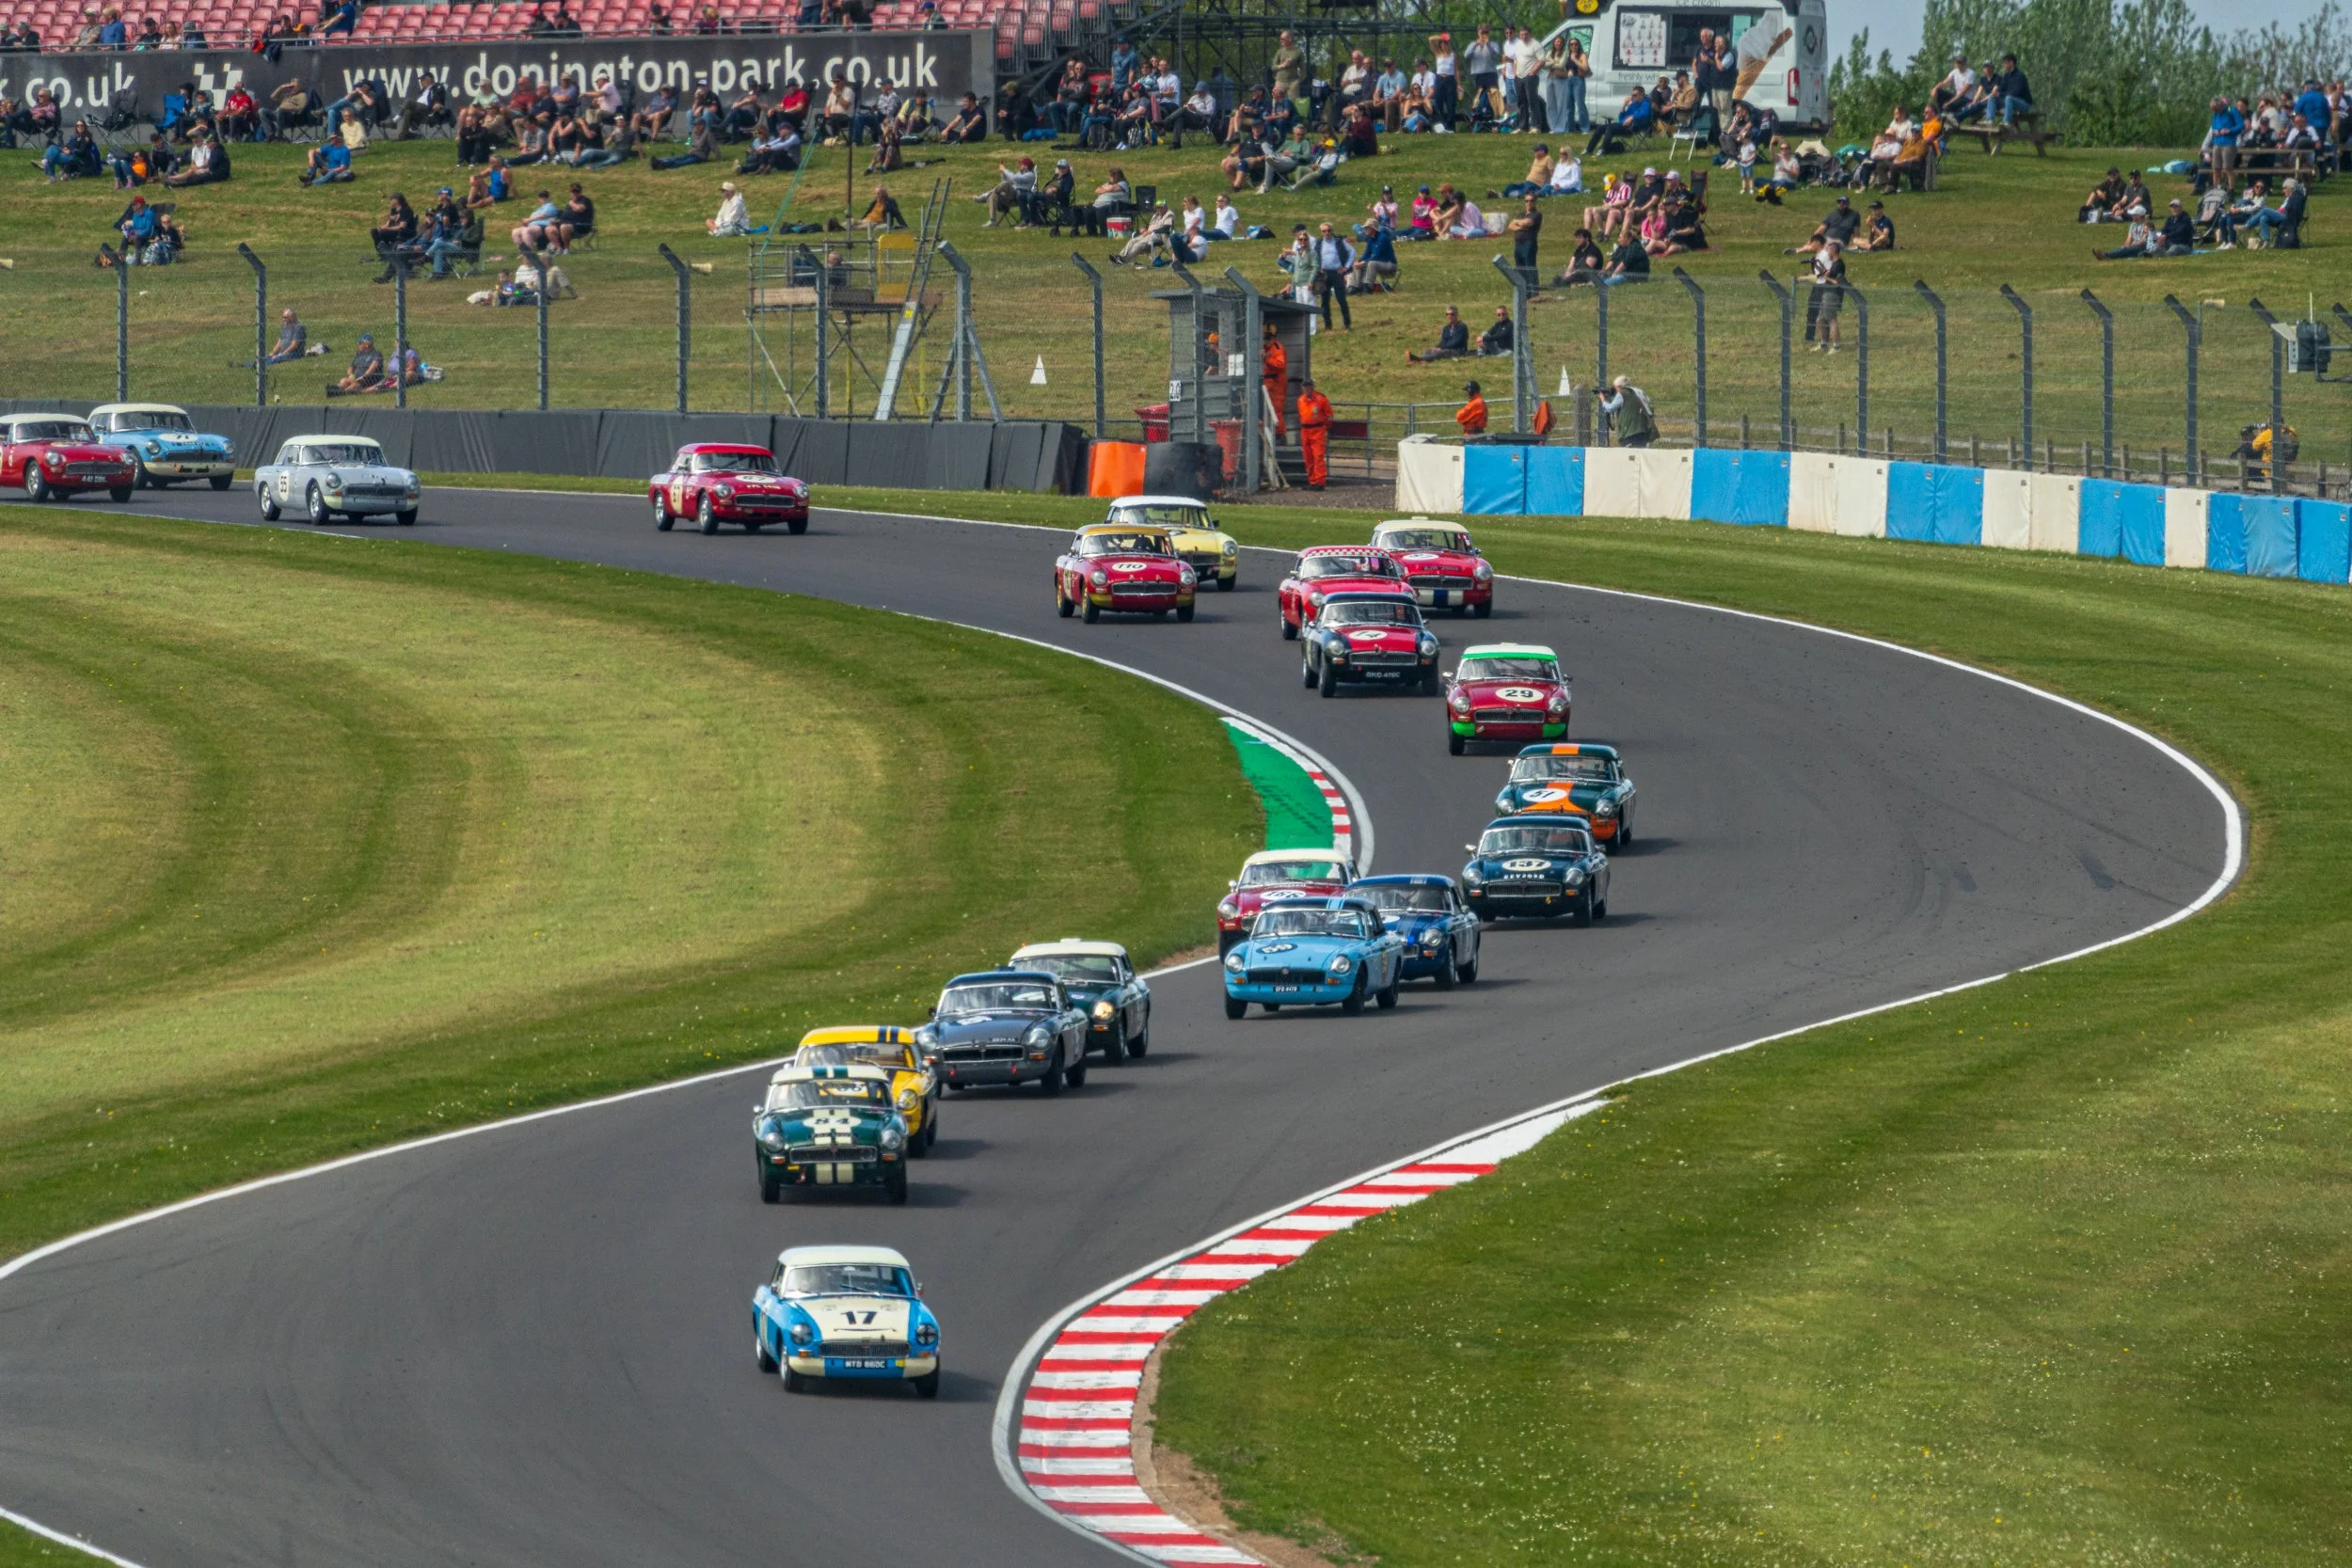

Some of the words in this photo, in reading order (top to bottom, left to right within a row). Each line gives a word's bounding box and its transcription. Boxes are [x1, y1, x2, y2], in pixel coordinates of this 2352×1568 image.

[1505, 689, 1534, 698] 29
[1529, 790, 1555, 799] 51
[840, 1310, 877, 1324] 17
